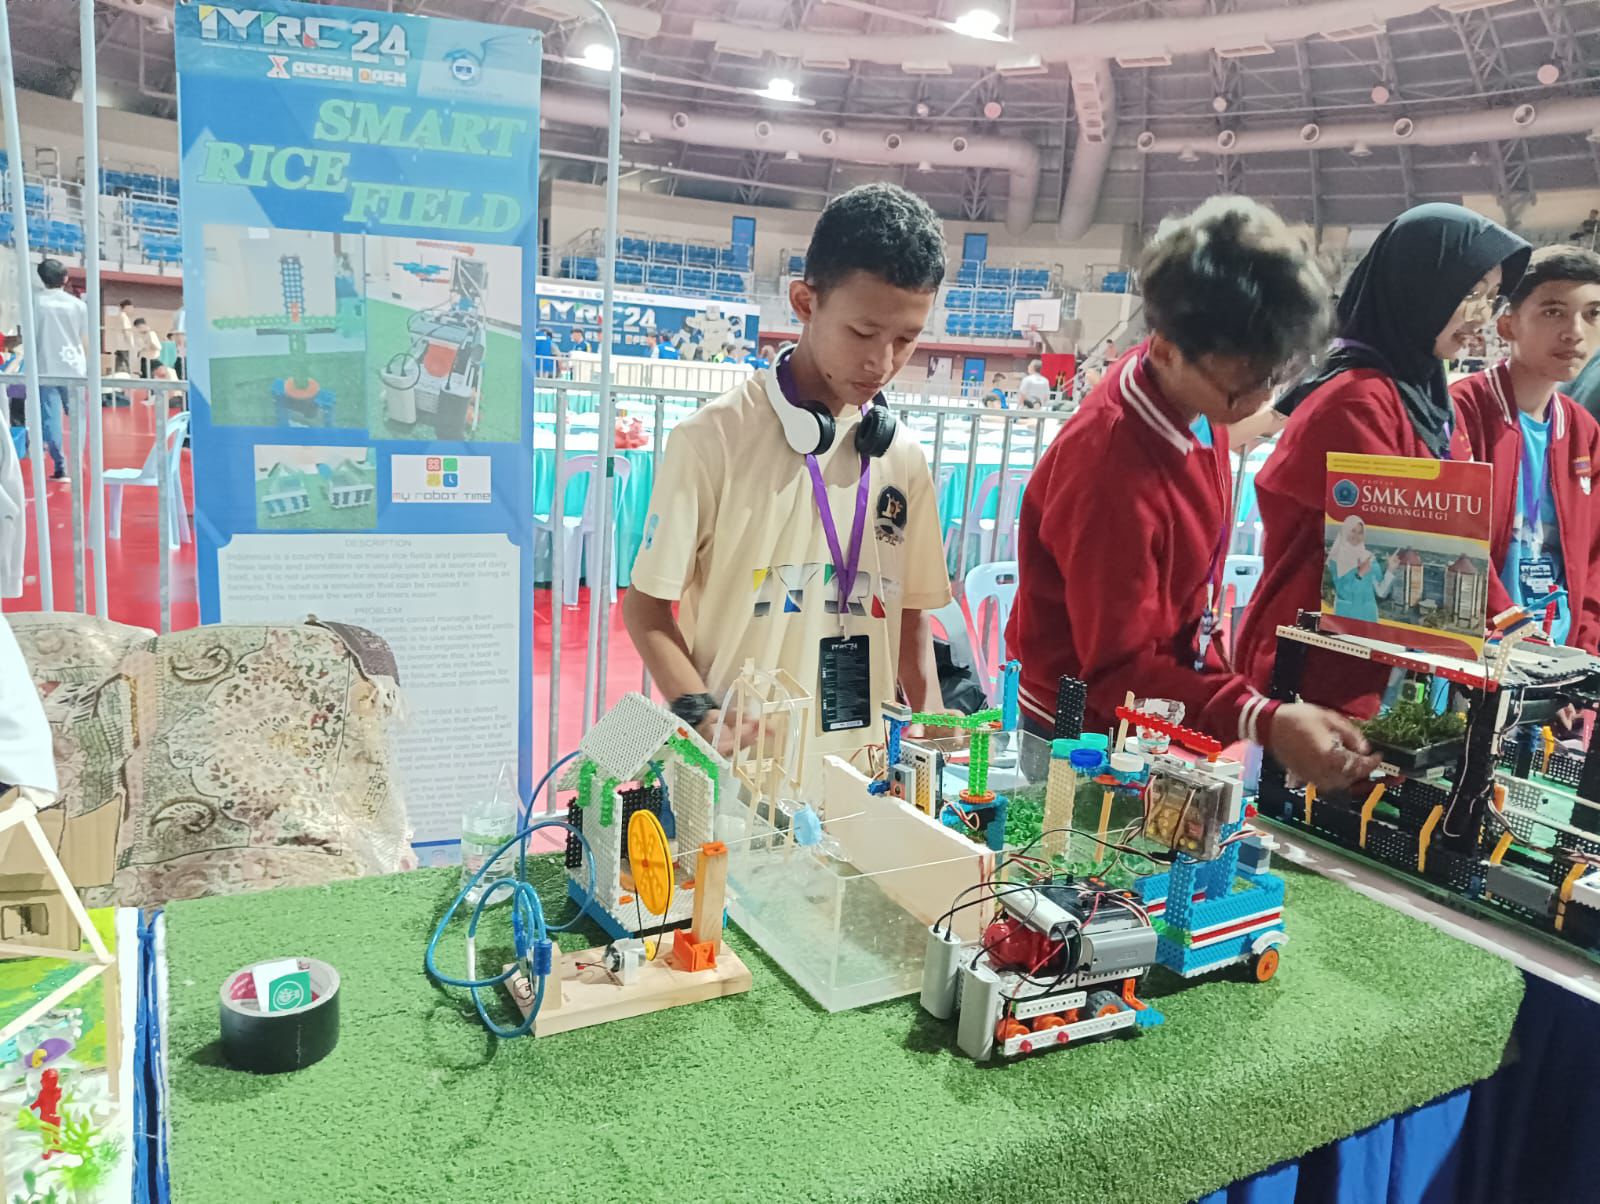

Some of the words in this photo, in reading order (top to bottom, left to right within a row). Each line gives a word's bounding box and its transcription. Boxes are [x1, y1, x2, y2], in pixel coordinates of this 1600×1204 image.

[199, 5, 349, 48] IYRC
[352, 21, 410, 66] 24
[314, 99, 527, 157] SMART
[199, 141, 351, 193] RICE
[343, 182, 521, 233] FIELD
[393, 492, 410, 502] my
[415, 490, 457, 501] robot
[1362, 485, 1409, 508] SMK
[1414, 490, 1482, 515] MUTU
[1361, 504, 1449, 521] GONDANGLEGI
[344, 539, 412, 548] DESCRIPTION
[292, 552, 325, 562] country
[410, 551, 432, 560] fields
[435, 552, 450, 560] and
[354, 607, 402, 616] PROBLEM
